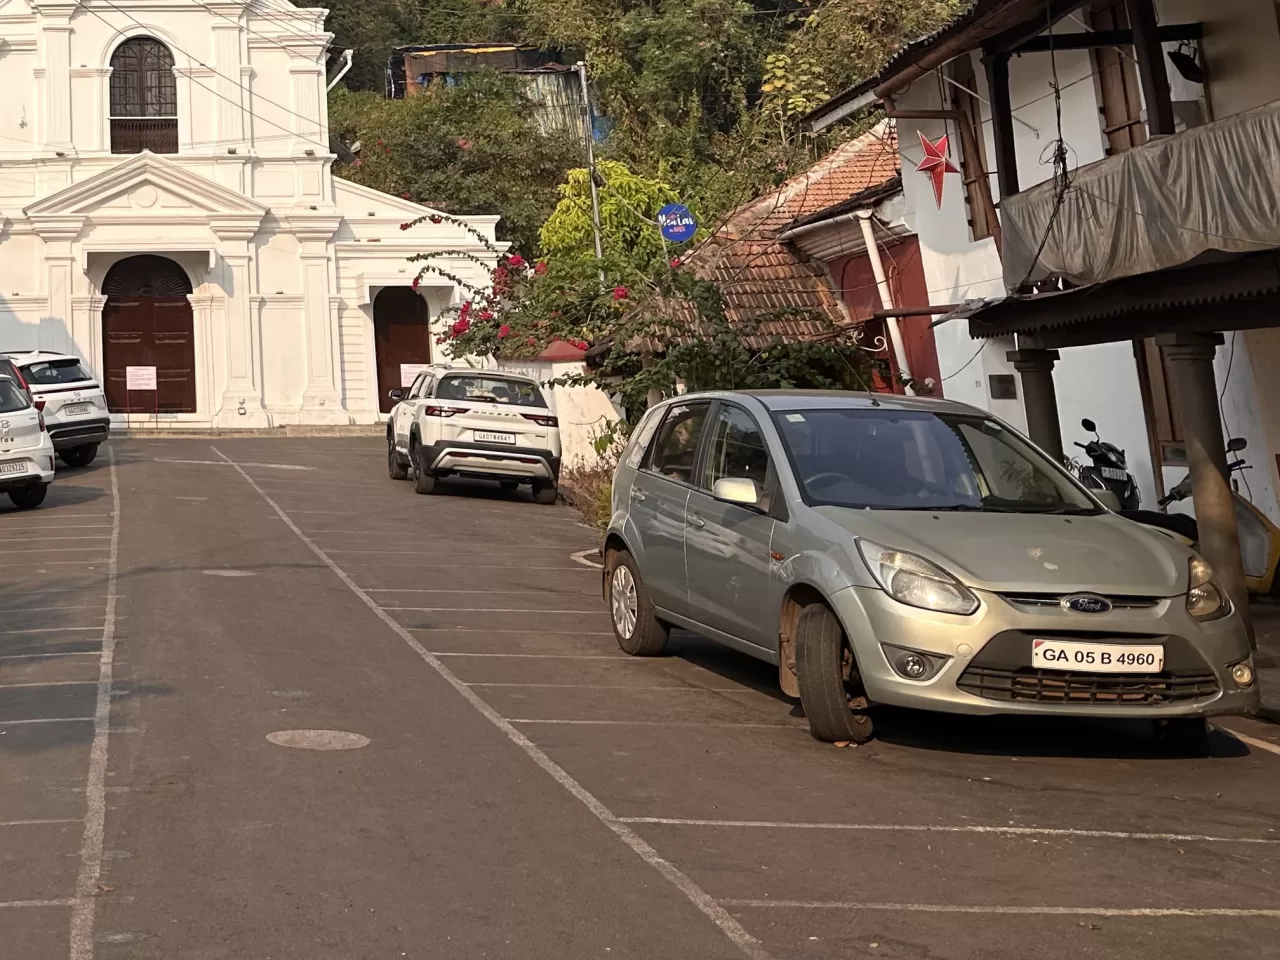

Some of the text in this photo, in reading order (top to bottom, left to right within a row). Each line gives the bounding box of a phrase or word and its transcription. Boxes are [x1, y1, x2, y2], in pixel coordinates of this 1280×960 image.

[1077, 598, 1101, 610] Ford
[1043, 648, 1155, 666] GA 05 B 4960
